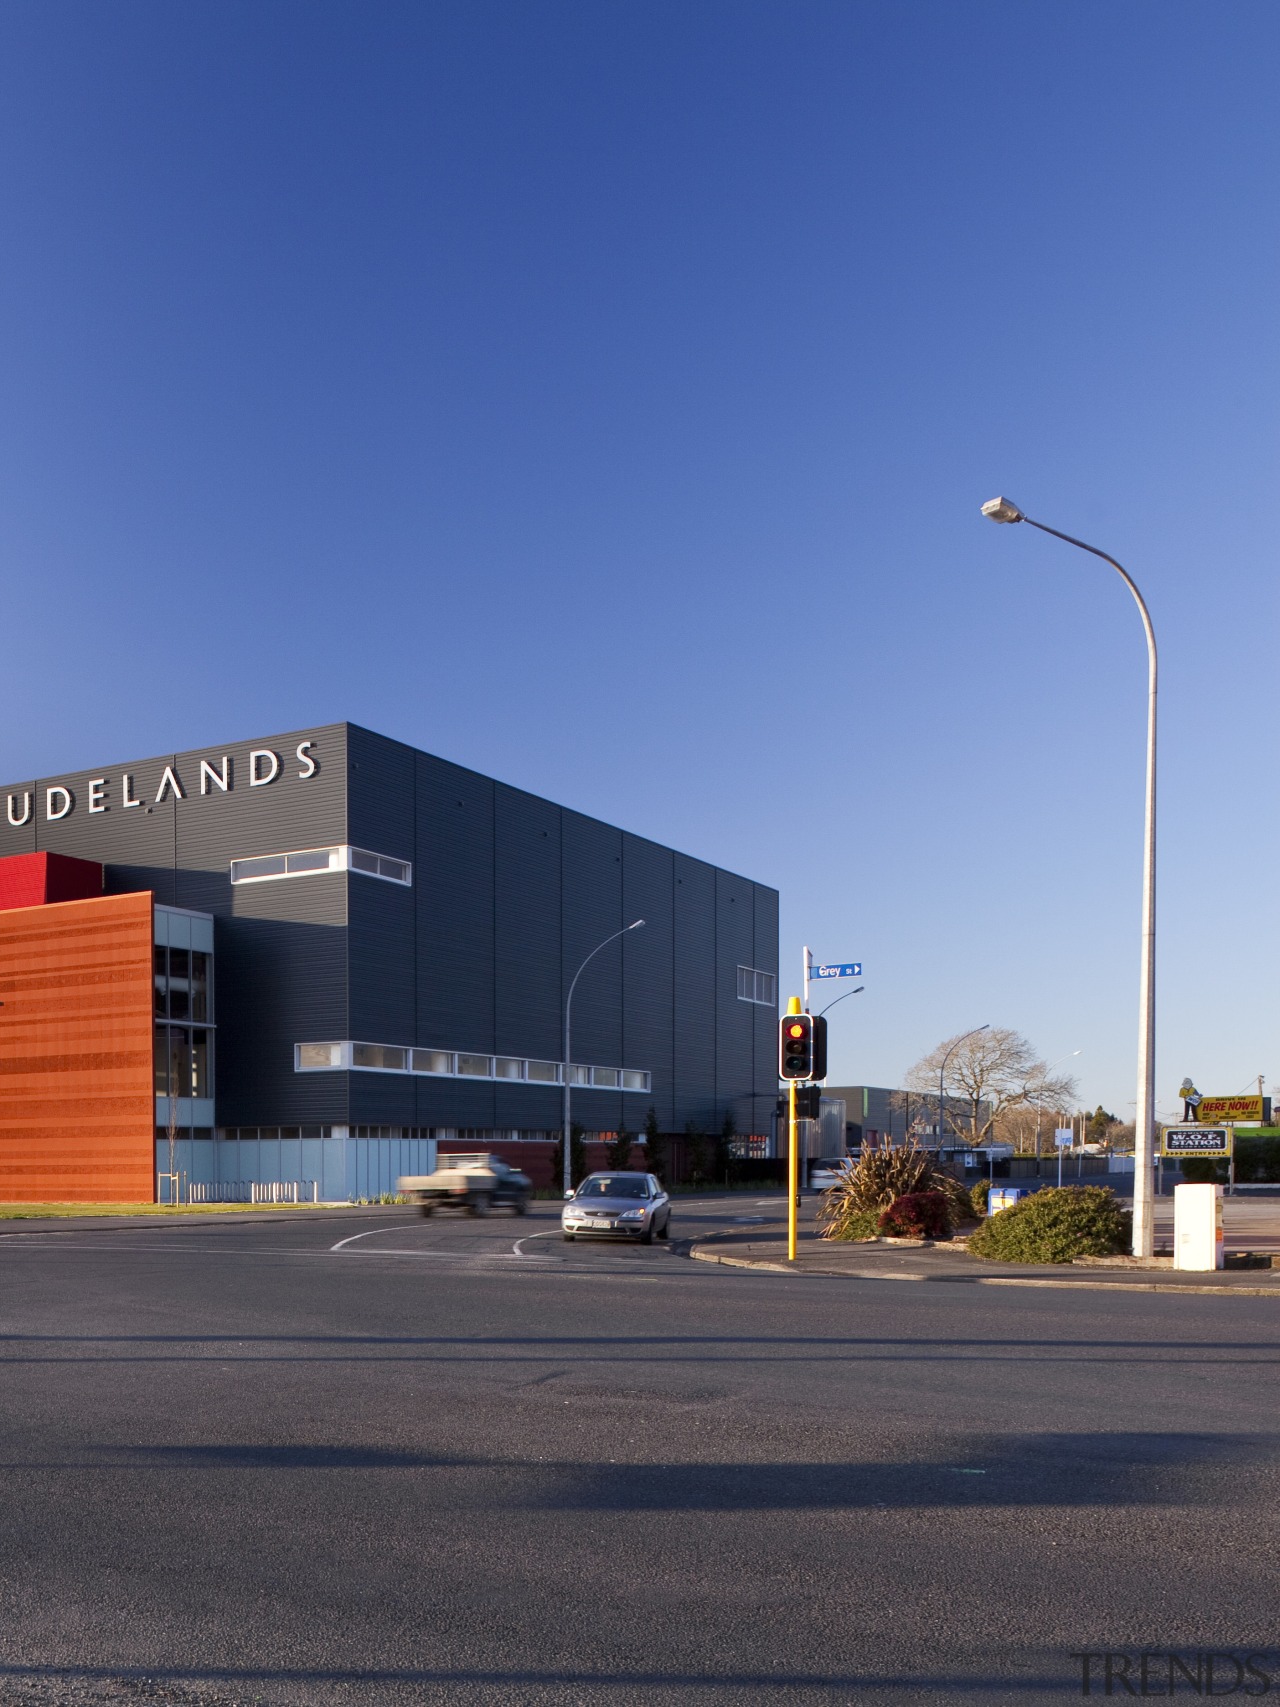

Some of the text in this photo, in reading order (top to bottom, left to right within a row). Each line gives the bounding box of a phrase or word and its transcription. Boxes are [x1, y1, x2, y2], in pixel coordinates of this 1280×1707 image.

[819, 966, 841, 977] Grey
[1202, 1100, 1259, 1111] HERE NOW!!
